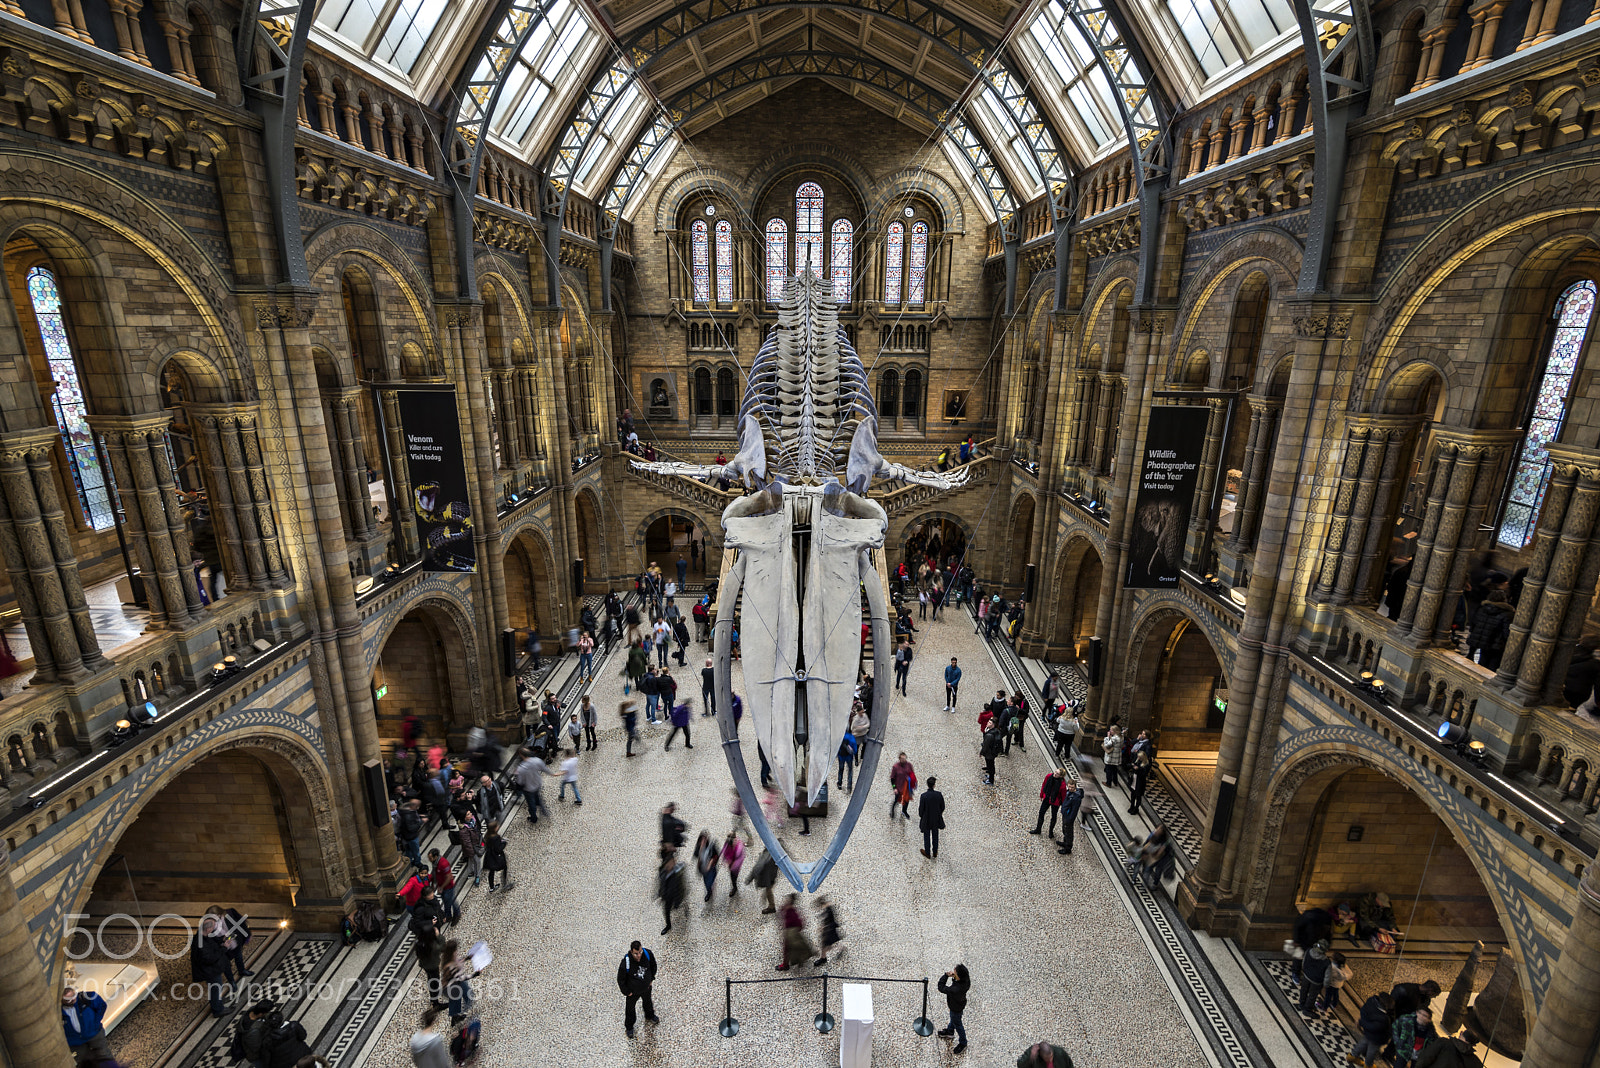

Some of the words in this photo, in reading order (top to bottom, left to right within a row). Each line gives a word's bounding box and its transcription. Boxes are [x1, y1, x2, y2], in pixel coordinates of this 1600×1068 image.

[408, 434, 433, 443] Venom
[424, 454, 442, 462] today
[1149, 449, 1177, 459] Wildlife
[1146, 461, 1196, 471] Photographer
[1145, 471, 1154, 480] of
[1153, 471, 1166, 480] the
[1167, 472, 1184, 480] Year
[1143, 482, 1157, 490] Visit
[1157, 483, 1175, 492] today
